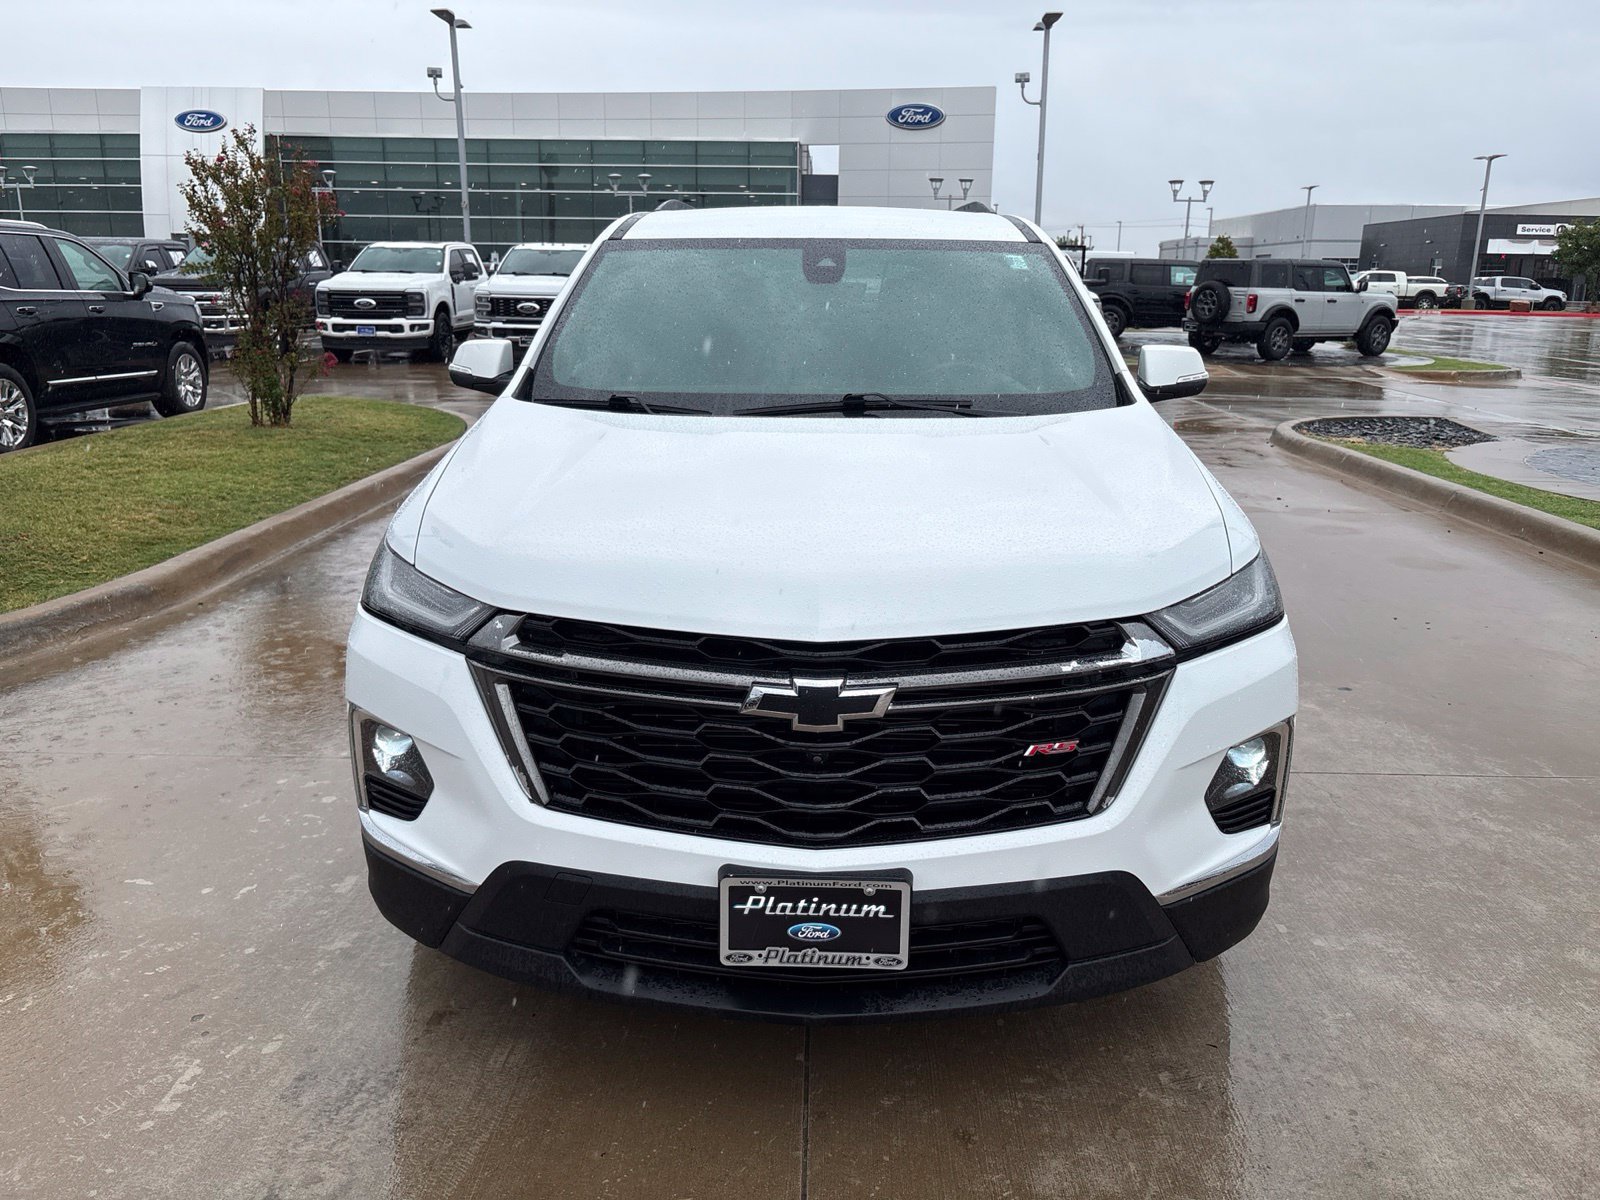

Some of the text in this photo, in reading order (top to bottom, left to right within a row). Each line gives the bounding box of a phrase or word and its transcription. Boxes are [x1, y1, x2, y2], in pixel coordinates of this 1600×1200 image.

[184, 113, 214, 126] Ford
[898, 107, 933, 123] Ford
[1520, 225, 1552, 233] Service
[1023, 740, 1080, 757] RS
[739, 879, 892, 889] www.PlatinumFord.com
[732, 895, 895, 918] Platinum
[797, 925, 830, 939] Ford
[763, 947, 871, 966] Platinum
